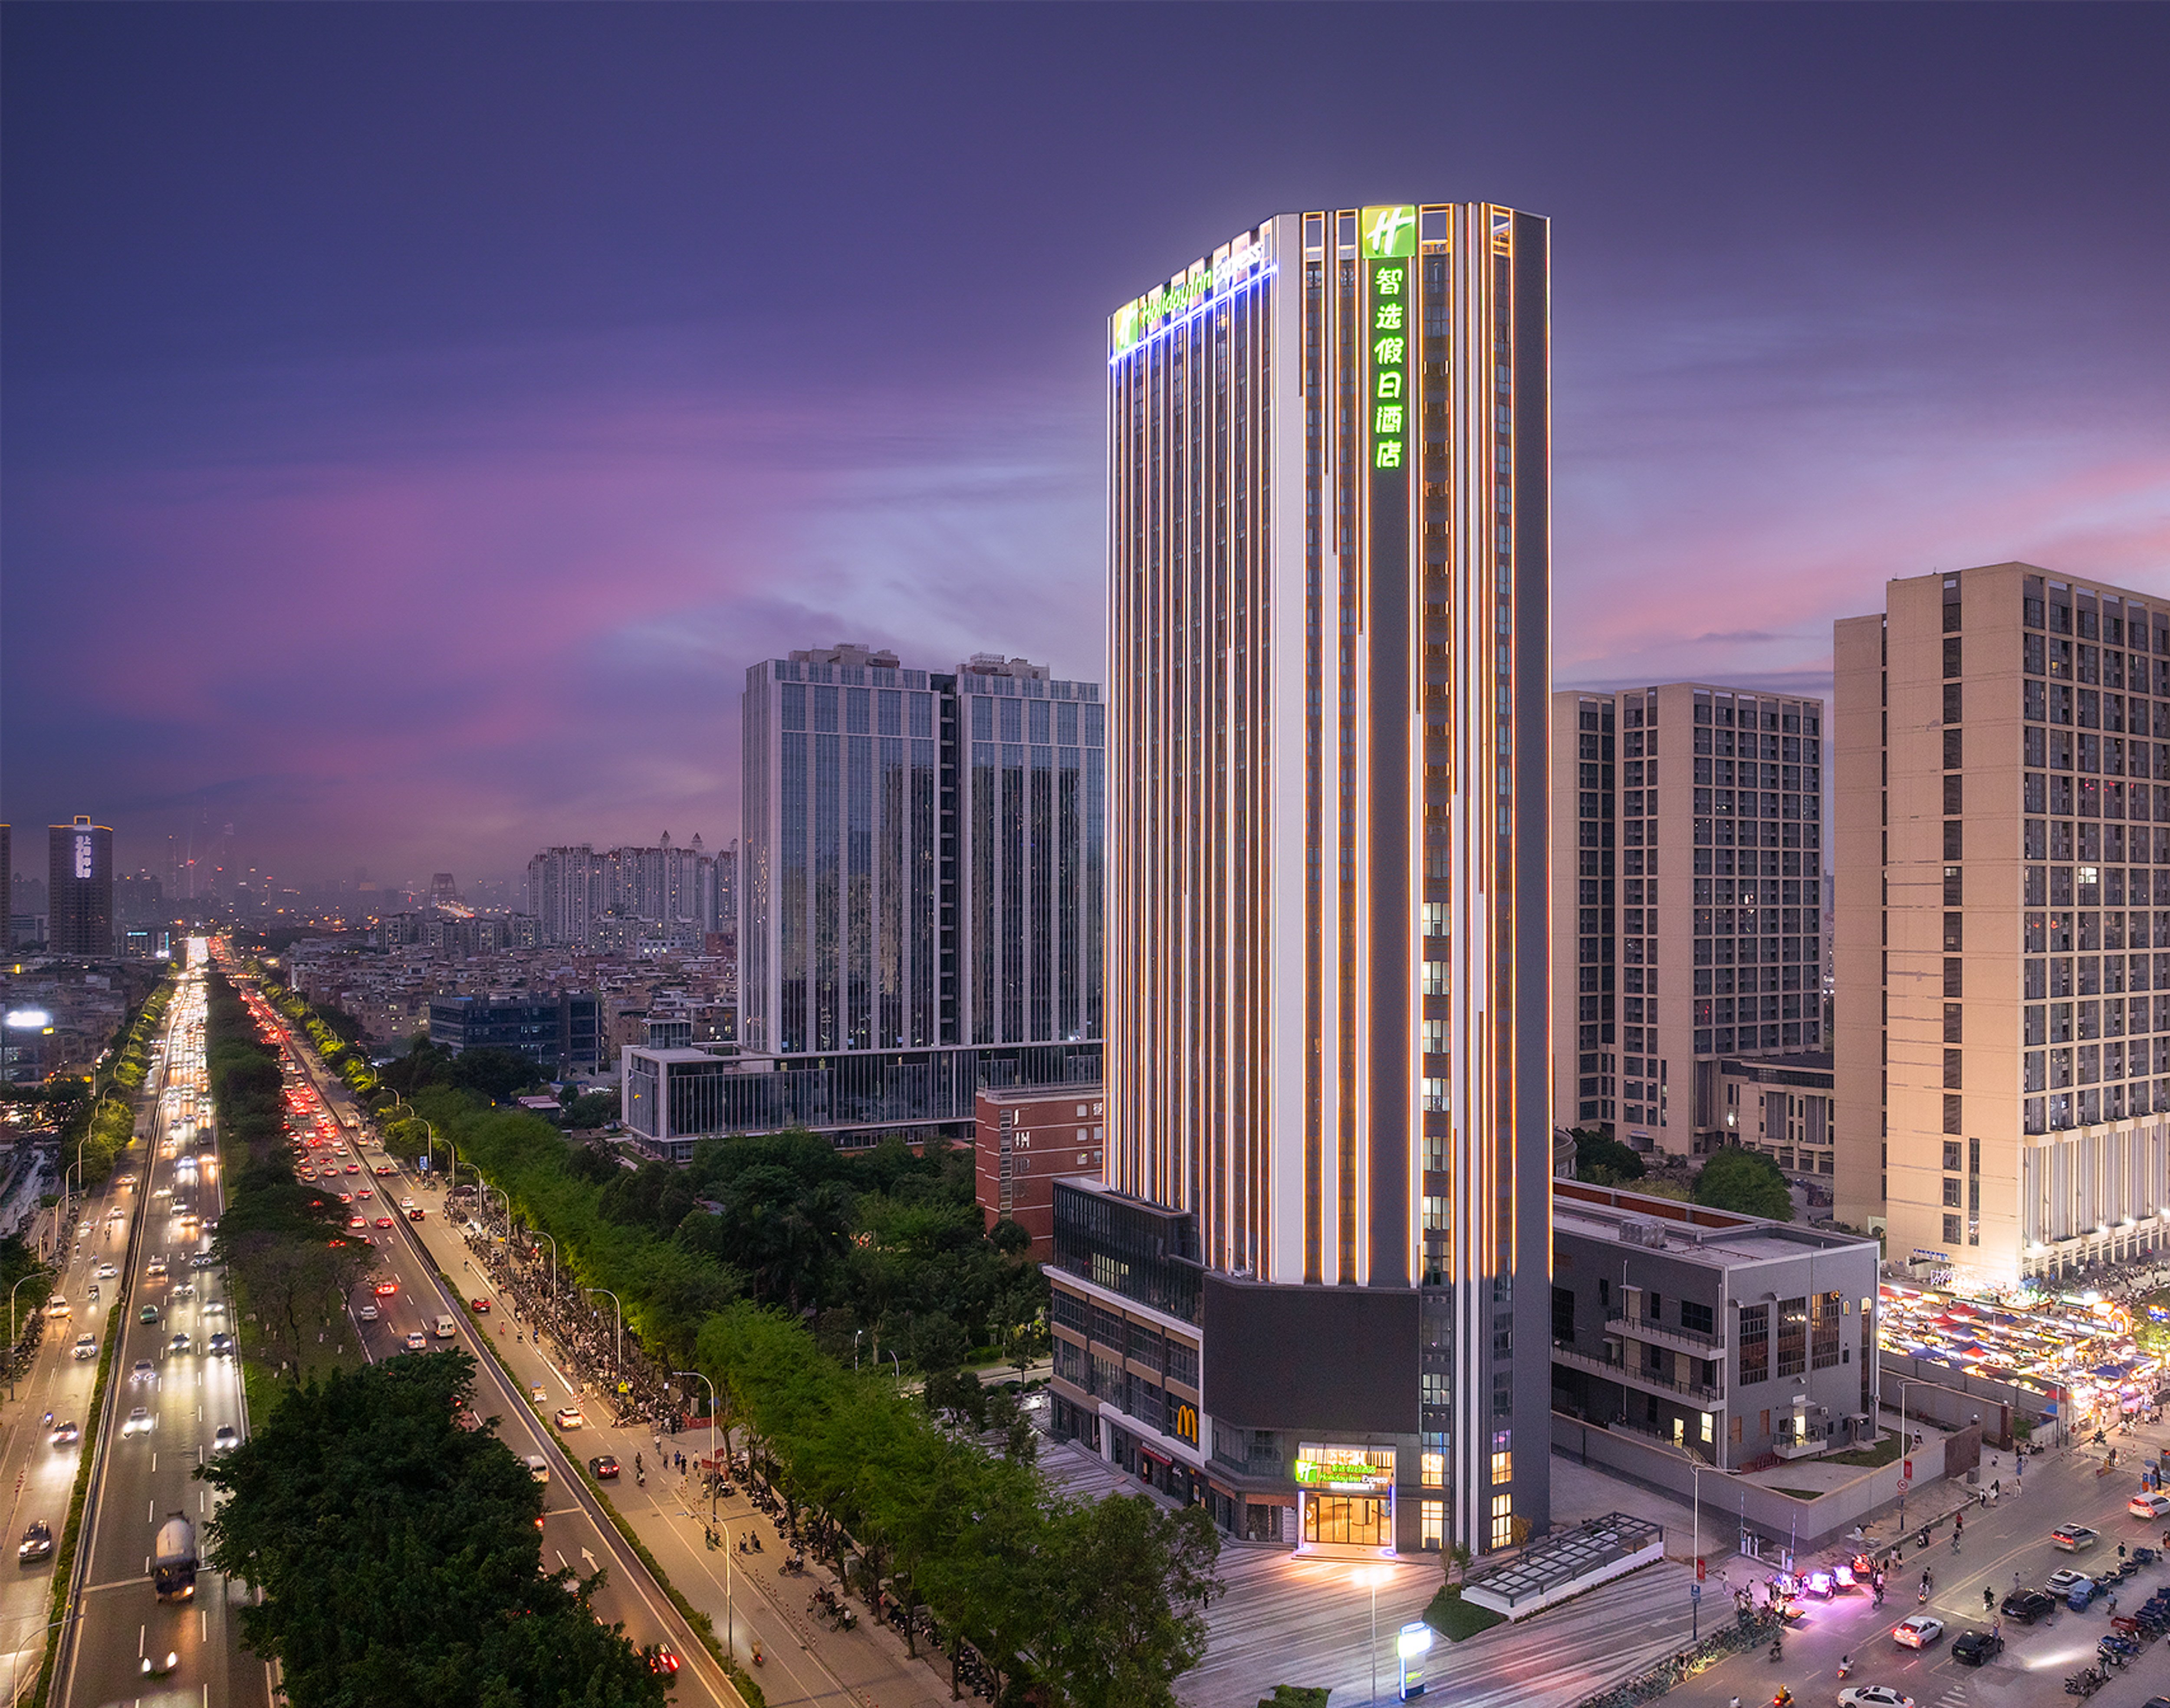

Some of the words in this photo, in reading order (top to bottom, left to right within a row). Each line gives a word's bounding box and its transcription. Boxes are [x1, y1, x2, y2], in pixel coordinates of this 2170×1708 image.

[1140, 283, 1191, 327] Holiday
[1192, 269, 1213, 297] Inn
[1373, 267, 1404, 470] 智选假日酒店
[1348, 1474, 1361, 1482] Inn
